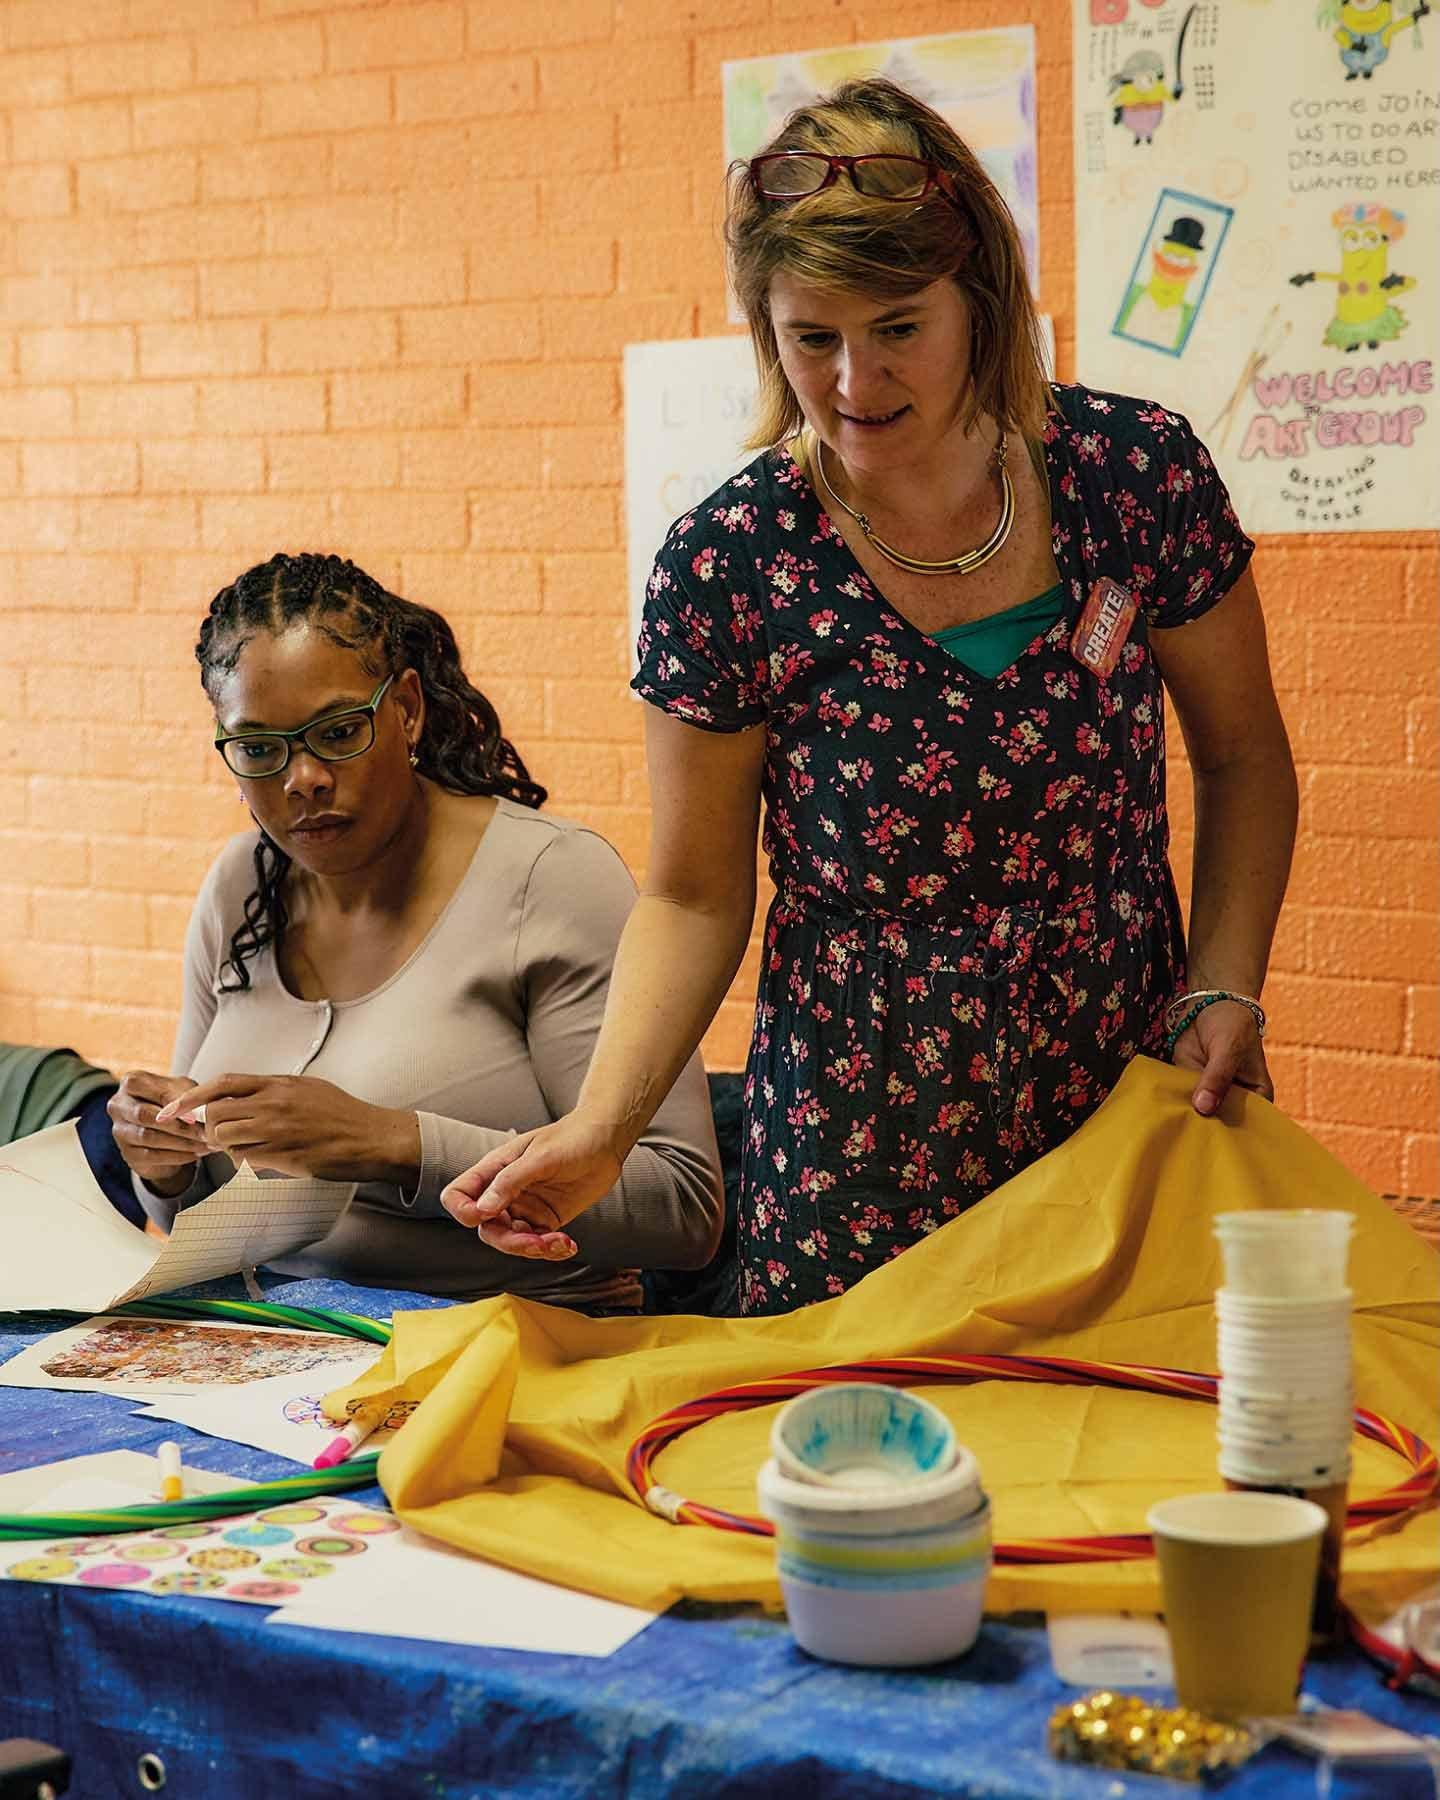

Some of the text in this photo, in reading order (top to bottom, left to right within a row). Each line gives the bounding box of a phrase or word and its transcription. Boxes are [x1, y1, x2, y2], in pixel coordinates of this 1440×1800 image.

[1330, 121, 1362, 141] TO
[1370, 122, 1401, 137] DO
[1253, 360, 1433, 409] WELCOME
[1238, 404, 1427, 461] ART GROUP
